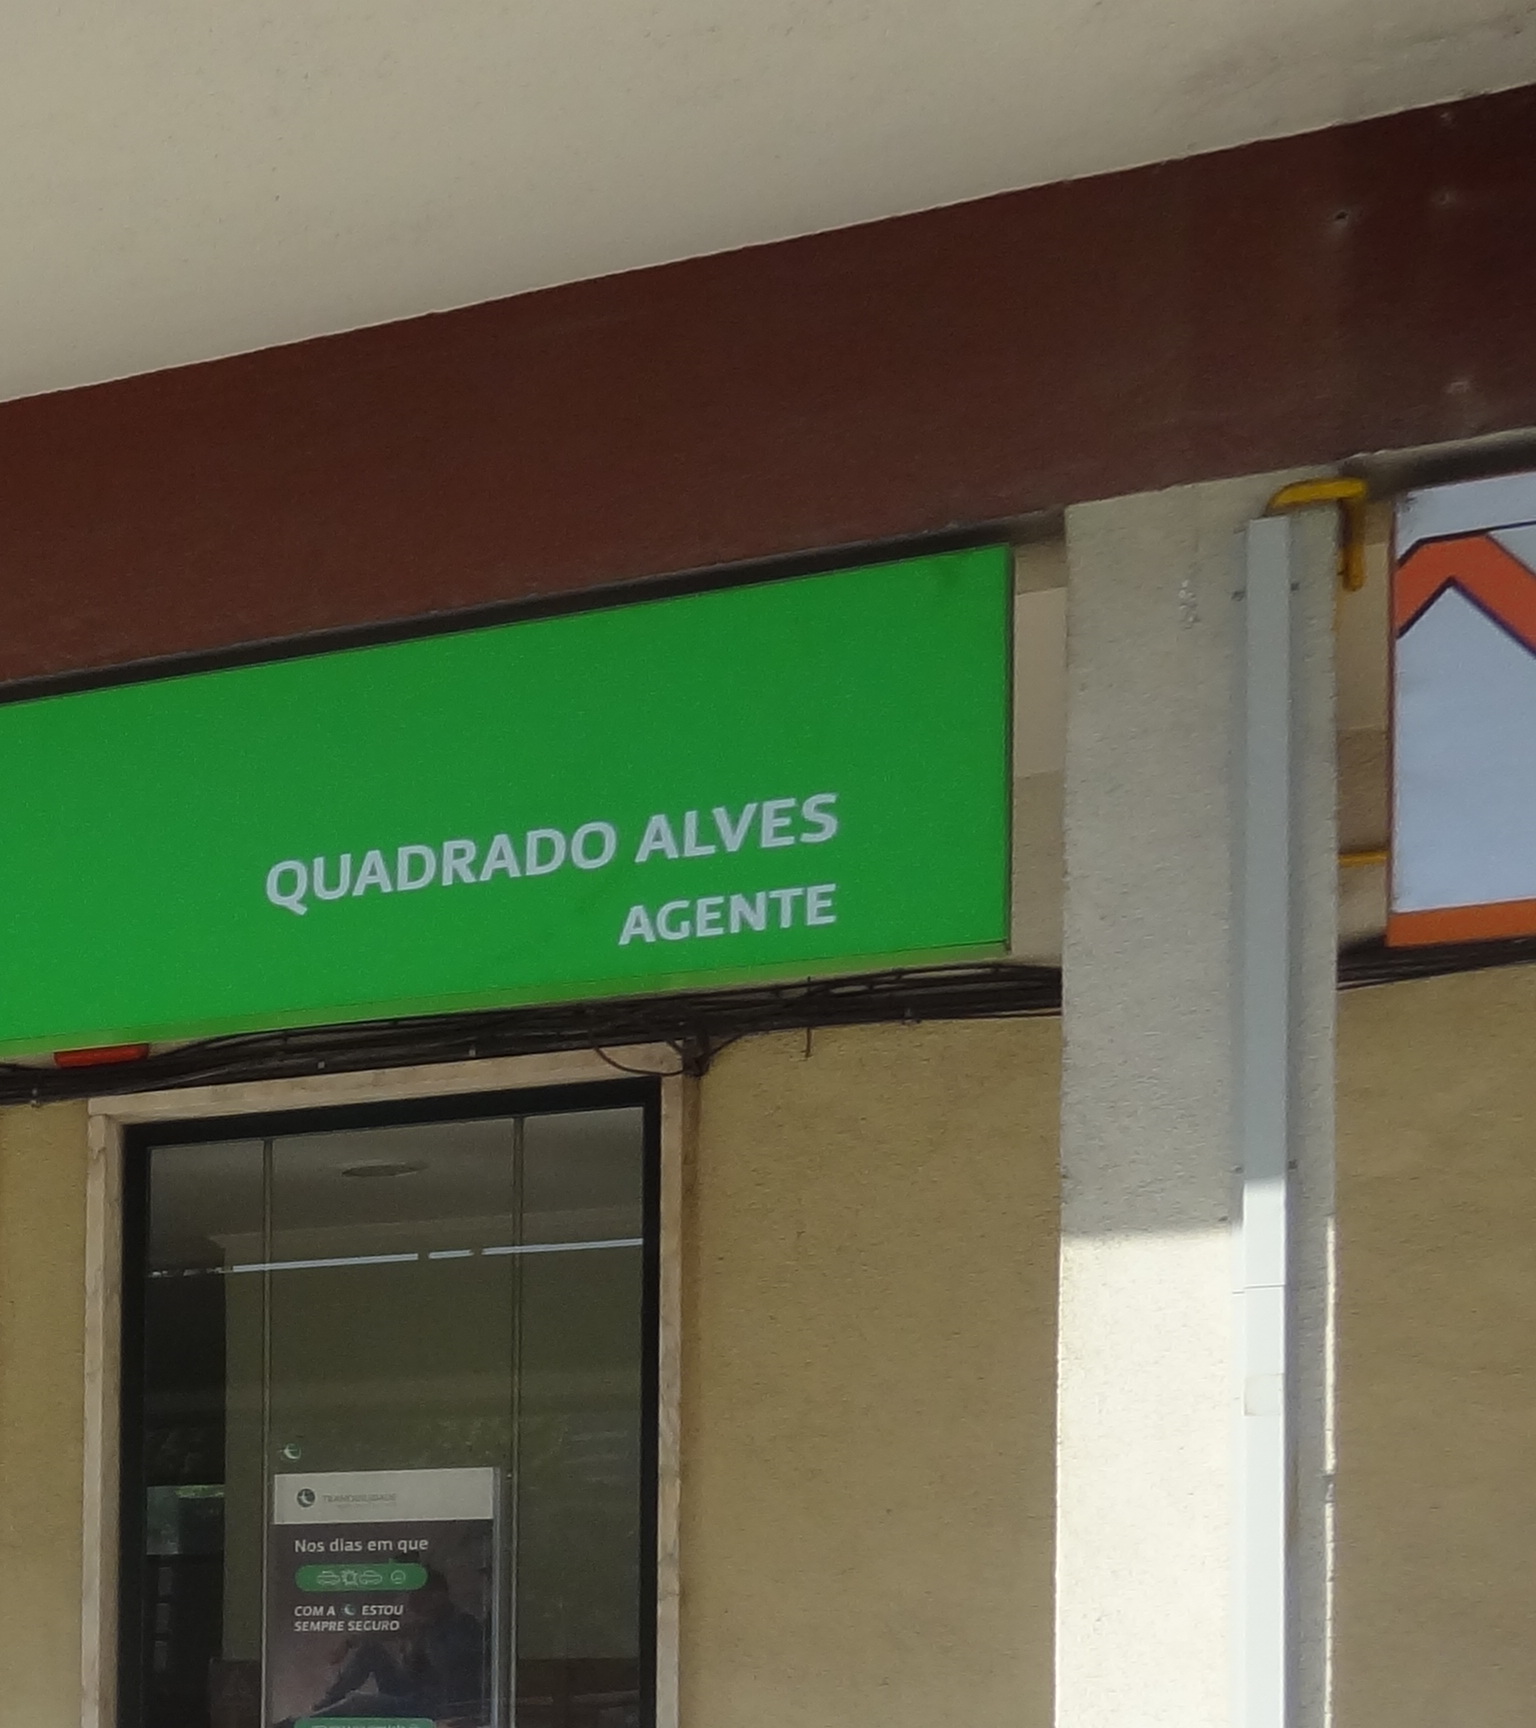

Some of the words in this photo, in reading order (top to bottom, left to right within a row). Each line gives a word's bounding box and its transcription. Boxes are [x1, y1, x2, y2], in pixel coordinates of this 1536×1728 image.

[266, 821, 617, 915] QUADRADO
[634, 793, 839, 863] ALVES
[618, 883, 837, 945] AGENTE
[294, 1539, 325, 1552] Nos
[329, 1538, 363, 1552] dias
[367, 1540, 394, 1551] em
[397, 1539, 429, 1553] que
[294, 1605, 324, 1617] COM
[325, 1605, 336, 1616] A
[362, 1604, 404, 1616] ESTOU
[294, 1620, 345, 1632] SEMPRE
[347, 1620, 400, 1631] SEGURO
